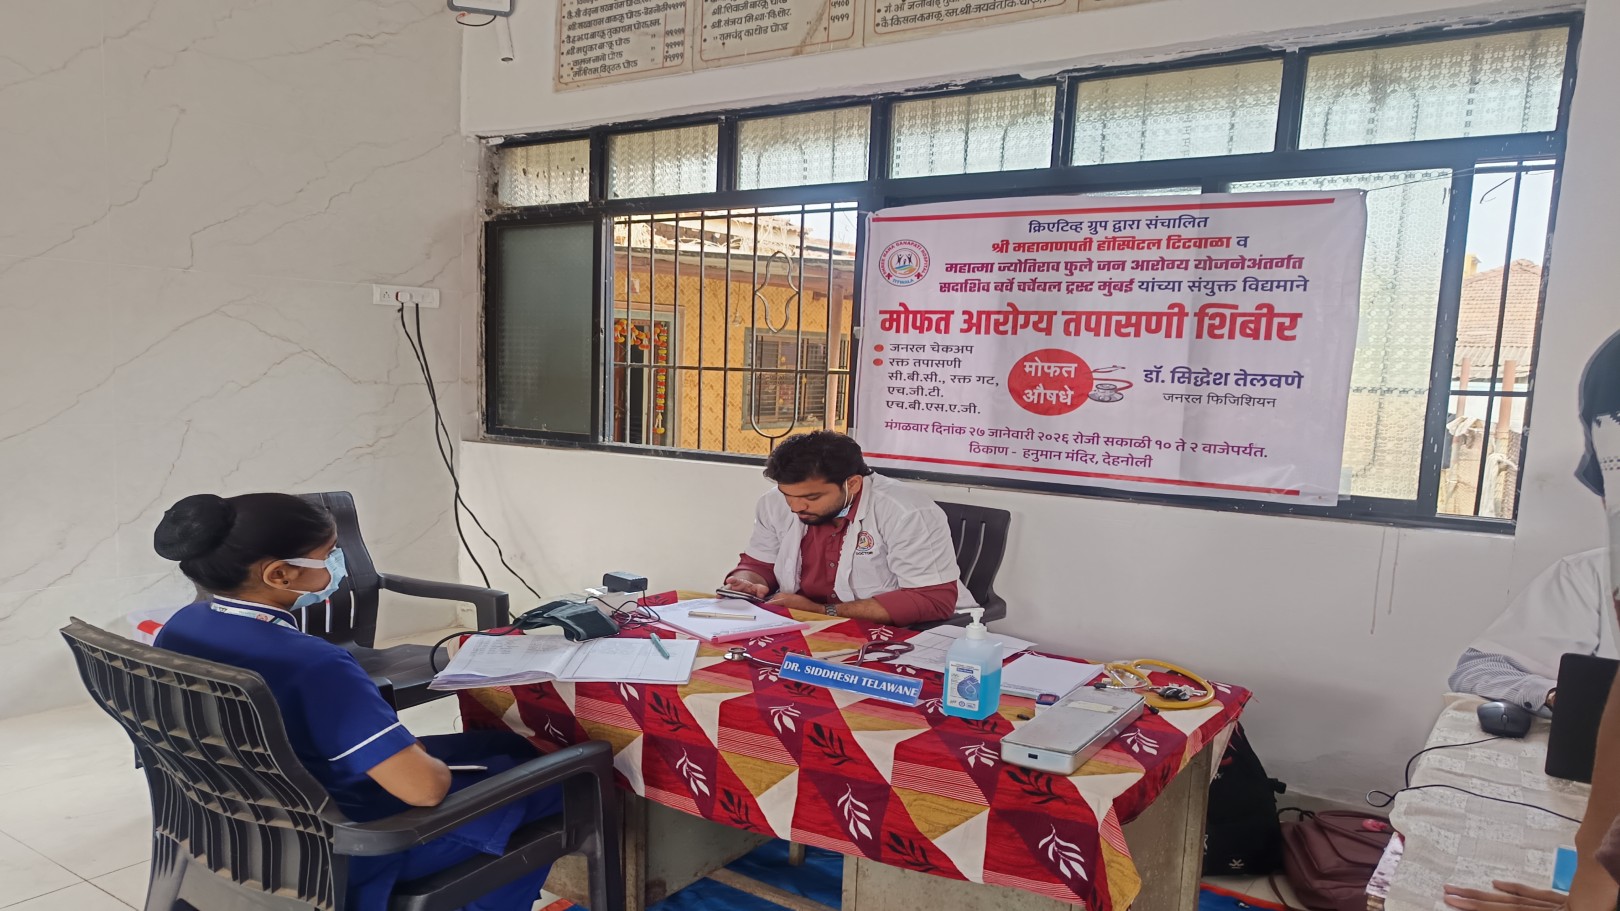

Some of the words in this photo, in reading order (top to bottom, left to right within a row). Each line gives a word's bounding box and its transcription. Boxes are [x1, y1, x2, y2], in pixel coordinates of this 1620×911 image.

[1028, 219, 1084, 233] क्रिएटिव्ह
[1087, 220, 1109, 235] ग्रुप
[1113, 219, 1142, 232] द्वारा
[1146, 214, 1210, 230] संचालित
[992, 239, 1010, 253] श्री
[1013, 237, 1094, 253] महागणपती
[1097, 235, 1163, 252] हॉस्पिटल
[1166, 234, 1232, 250] टिटवाळा
[1236, 236, 1250, 248] व
[945, 262, 995, 274] महात्मा
[998, 258, 1061, 273] ज्योतिराव
[1064, 257, 1094, 276] फुले
[1097, 260, 1127, 272] जन
[1131, 256, 1190, 271] आरोग्य
[1194, 254, 1305, 271] योजनेअंतर्गत
[939, 278, 991, 293] सदाशिव
[994, 277, 1016, 293] बर्वे
[1017, 277, 1062, 293] चर्चेबल
[1065, 280, 1095, 295] ट्रस्ट
[1098, 277, 1135, 297] मुंबई
[1138, 277, 1183, 293] यांच्या
[1187, 276, 1237, 297] संयुक्त
[1242, 275, 1309, 293] विद्यमाने
[879, 302, 955, 335] मोफत
[959, 302, 1057, 337] आरोग्य
[1061, 302, 1189, 339] तपासणी
[1194, 302, 1303, 341] शिबीर
[889, 343, 926, 353] जनरल
[929, 342, 974, 355] चेकअप
[888, 357, 910, 367] रक्त
[913, 357, 962, 369] तपासणी
[1023, 357, 1078, 378] मोफत
[950, 374, 972, 384] रक्त
[975, 375, 999, 387] गट,
[1143, 365, 1165, 384] डॉ.
[1170, 366, 1231, 387] सिद्धेश
[1234, 369, 1305, 390] तेलवणे
[887, 385, 944, 398] एच.जी.टी.
[1022, 383, 1075, 406] औषधे
[1162, 392, 1203, 405] जनरल
[1206, 391, 1277, 408] फिजिशियन
[884, 419, 930, 433] मंगळवार
[931, 421, 967, 436] दिनांक
[969, 427, 985, 437] २७
[988, 427, 1035, 441] जानेवारी
[1037, 431, 1069, 445] २०२६
[1072, 431, 1101, 446] रोजी
[1103, 435, 1152, 450] सकाळी
[1155, 439, 1171, 450] १०
[1175, 438, 1188, 452] ते
[1190, 442, 1199, 453] २
[969, 441, 1010, 456] ठिकाण
[1023, 448, 1063, 463] हनुमान
[1065, 448, 1099, 465] मंदिर,
[1102, 451, 1153, 469] देहनोली
[783, 660, 800, 673] DR.
[804, 665, 859, 685] SIDDHESH
[861, 677, 919, 698] TELAWANE
